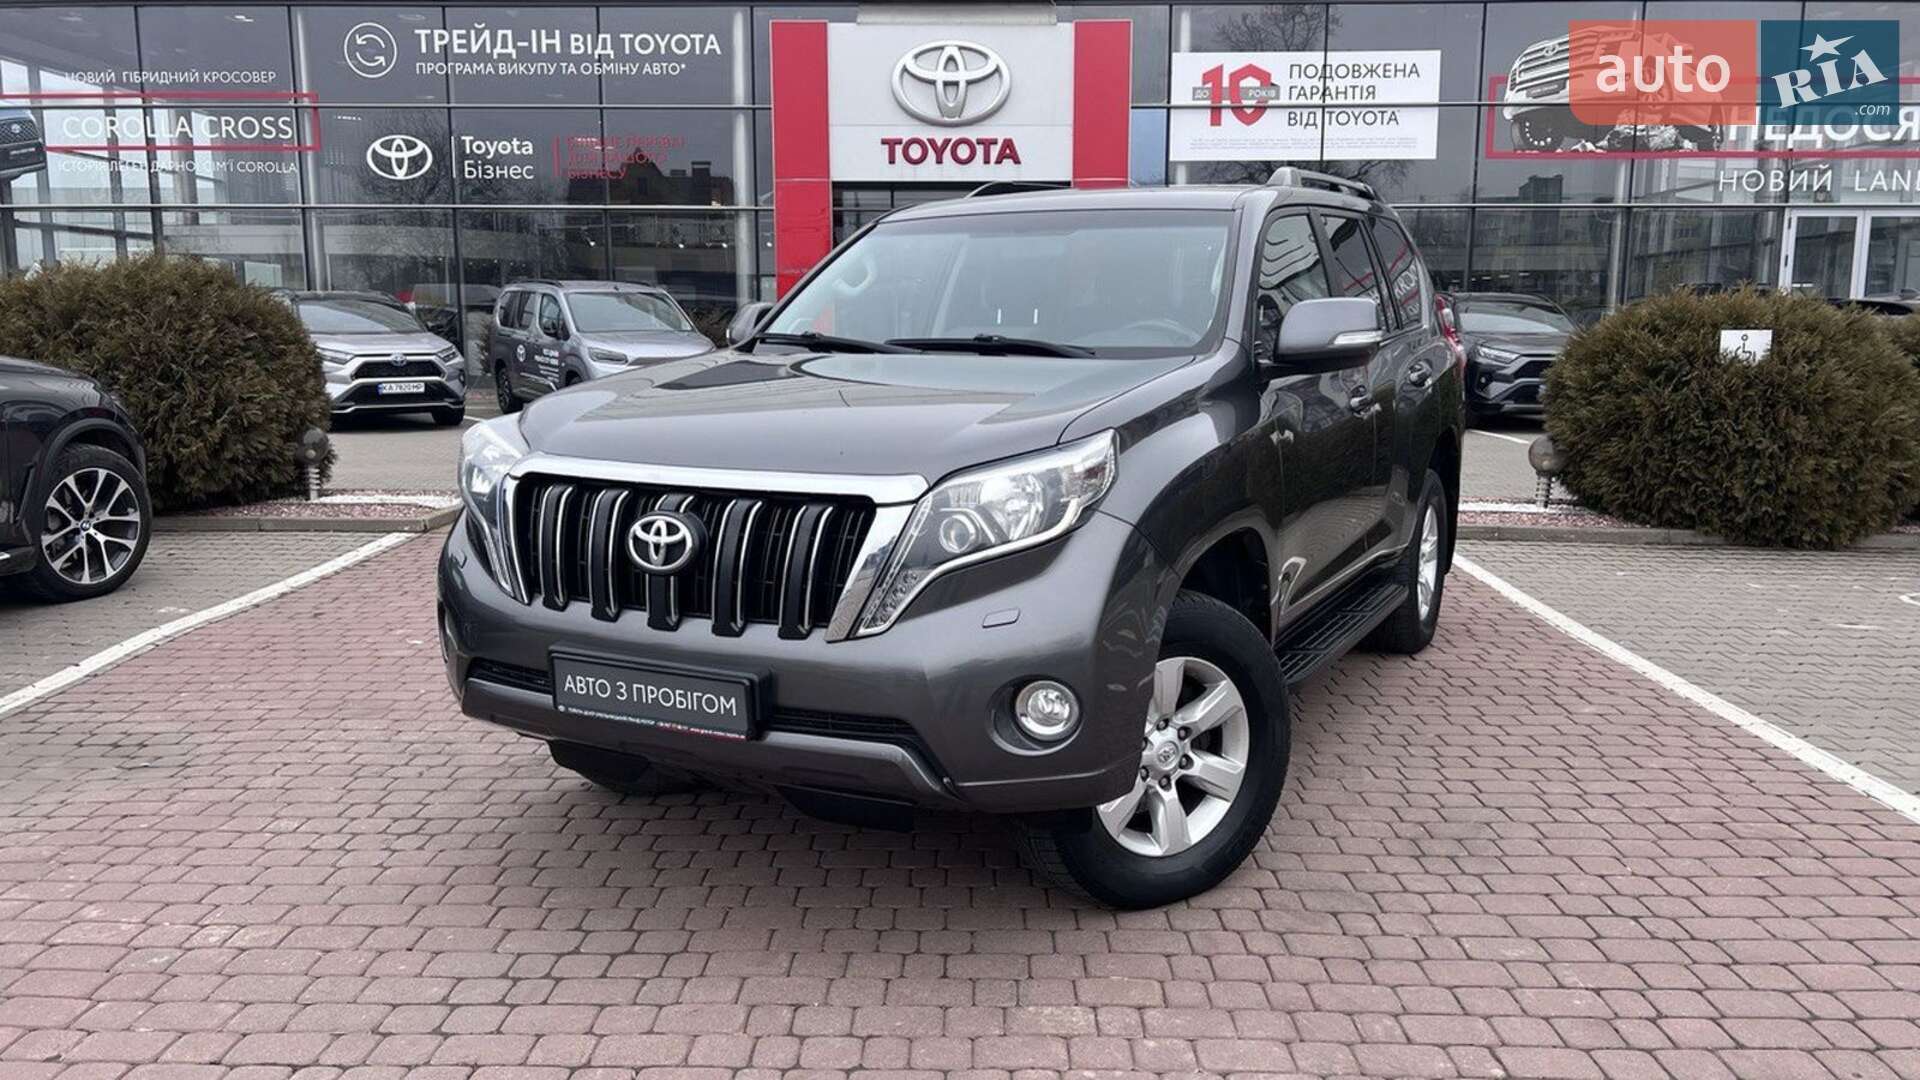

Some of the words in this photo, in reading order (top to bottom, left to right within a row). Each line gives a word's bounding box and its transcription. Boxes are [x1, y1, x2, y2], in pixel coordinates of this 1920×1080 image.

[414, 23, 561, 59] ТРЕЙД-ІН
[570, 34, 614, 59] ВІД
[620, 33, 722, 55] TOYOTA
[64, 69, 116, 84] НОВИЙ
[122, 69, 201, 85] ГІБРИДНИЙ
[203, 71, 277, 84] КРОСОВЕР
[416, 63, 495, 76] ПРОГРАМА
[499, 63, 556, 76] ВИКУПУ
[561, 63, 578, 76] ТА
[581, 63, 639, 76] ОБМІНУ
[1289, 63, 1421, 82] ПОДОВЖЕНА
[1288, 85, 1376, 101] ГАРАНТІЯ
[62, 116, 193, 139] COROLLA
[201, 116, 294, 140] CROSS
[1288, 111, 1318, 129] ВІД
[1326, 110, 1400, 126] TOYOTA
[461, 136, 534, 158] Toyota
[881, 138, 1022, 165] TOYOTA
[236, 161, 298, 174] COROLLA
[463, 160, 535, 180] Бізнес
[1718, 164, 1833, 192] НОВИЙ
[563, 674, 611, 699] АВТО
[616, 681, 628, 701] З
[632, 683, 738, 717] ПРОБІГОМ
